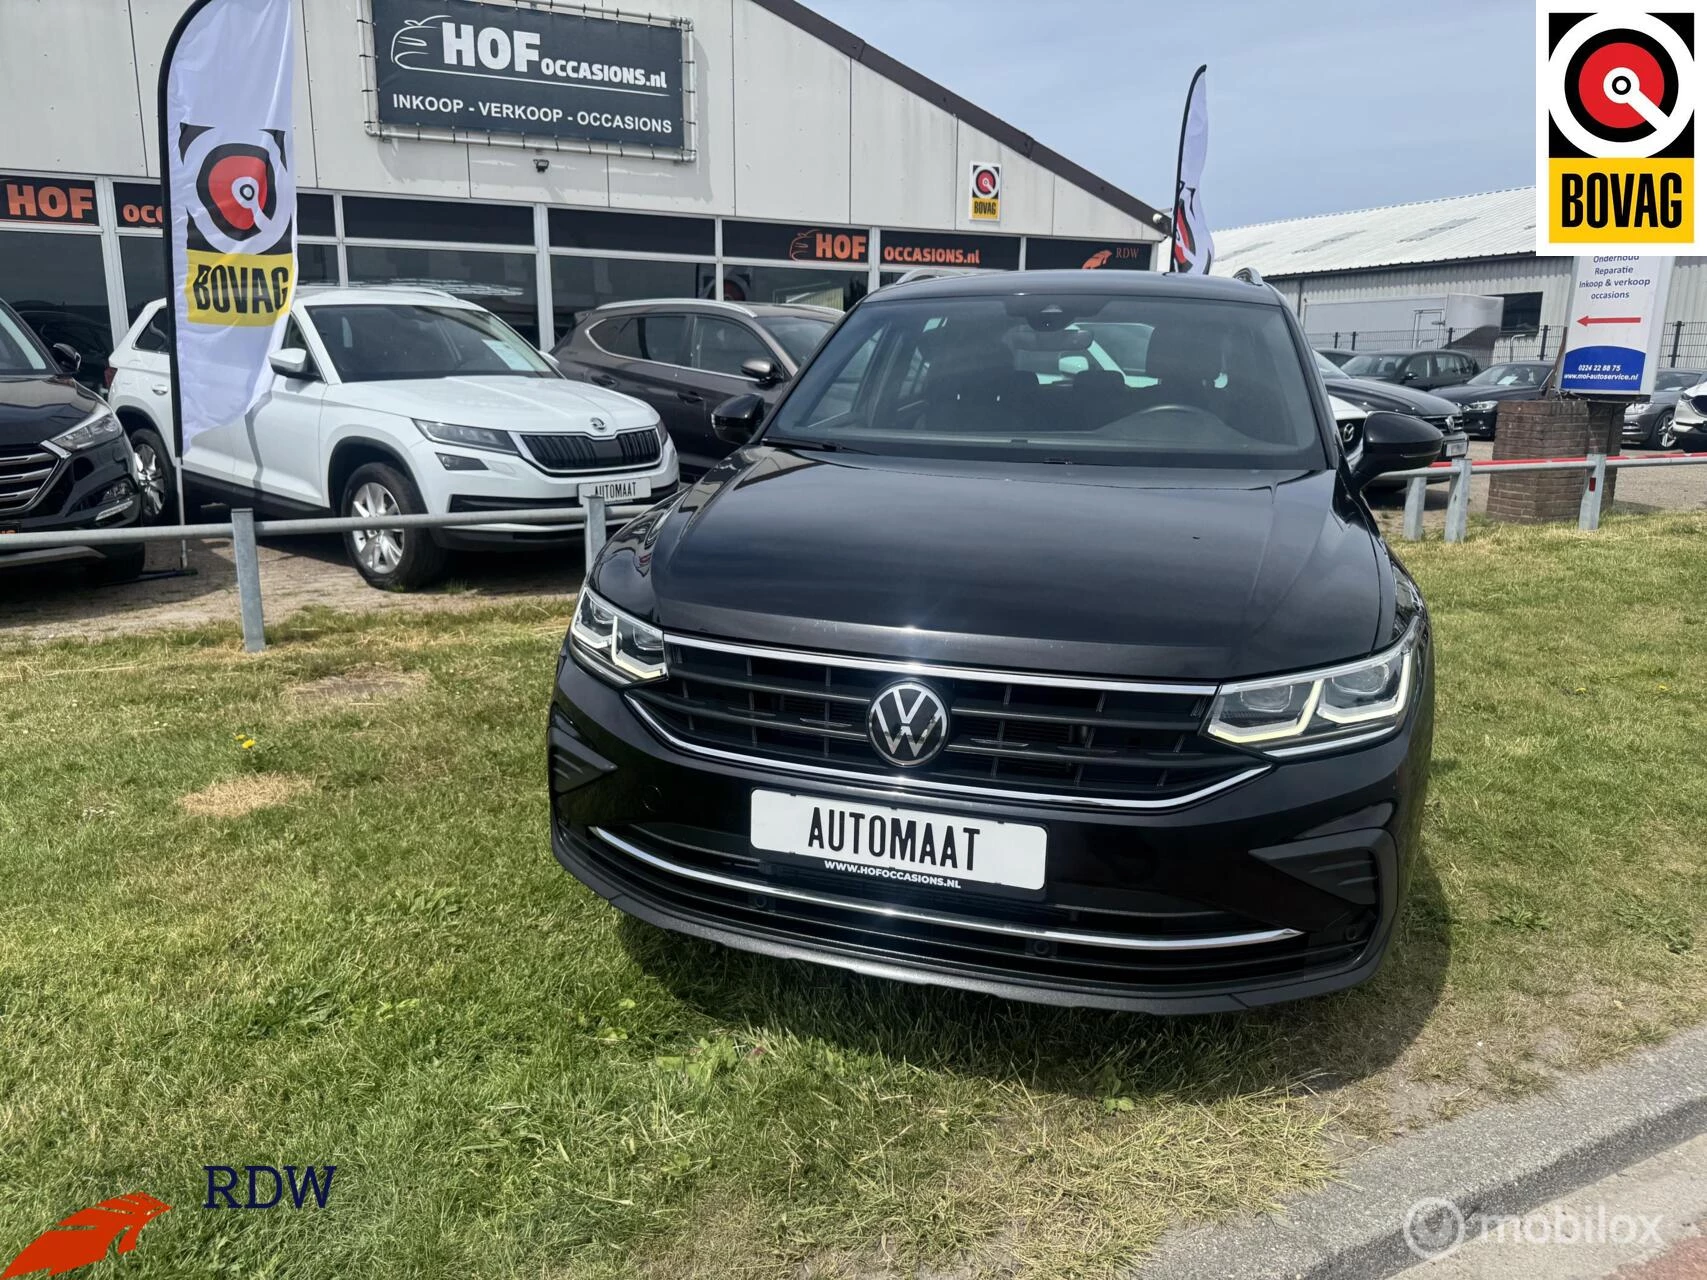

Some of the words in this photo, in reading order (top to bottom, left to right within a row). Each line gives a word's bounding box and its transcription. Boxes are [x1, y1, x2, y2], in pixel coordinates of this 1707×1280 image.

[442, 22, 541, 72] HOF
[541, 58, 667, 88] OCCASIONS.nl
[393, 93, 464, 113] INKOOP
[478, 101, 563, 122] VERKOOP
[577, 111, 672, 133] OCCASIONS
[6, 184, 93, 219] HOF
[974, 201, 997, 216] BOVAG
[815, 232, 867, 260] HOF
[884, 246, 980, 264] OCCASIONS.nl
[1116, 247, 1140, 259] RDW
[1579, 280, 1603, 288] Inkoop
[1605, 278, 1612, 287] &
[1614, 278, 1651, 287] verkoop
[1594, 265, 1634, 276] Reparatie
[193, 264, 289, 314] BOVAG
[1591, 291, 1630, 300] occasions
[594, 481, 637, 499] AUTOMAAT
[808, 806, 981, 871] AUTOMAAT
[824, 859, 961, 889] WWW.HOFOCCASIONS.NL
